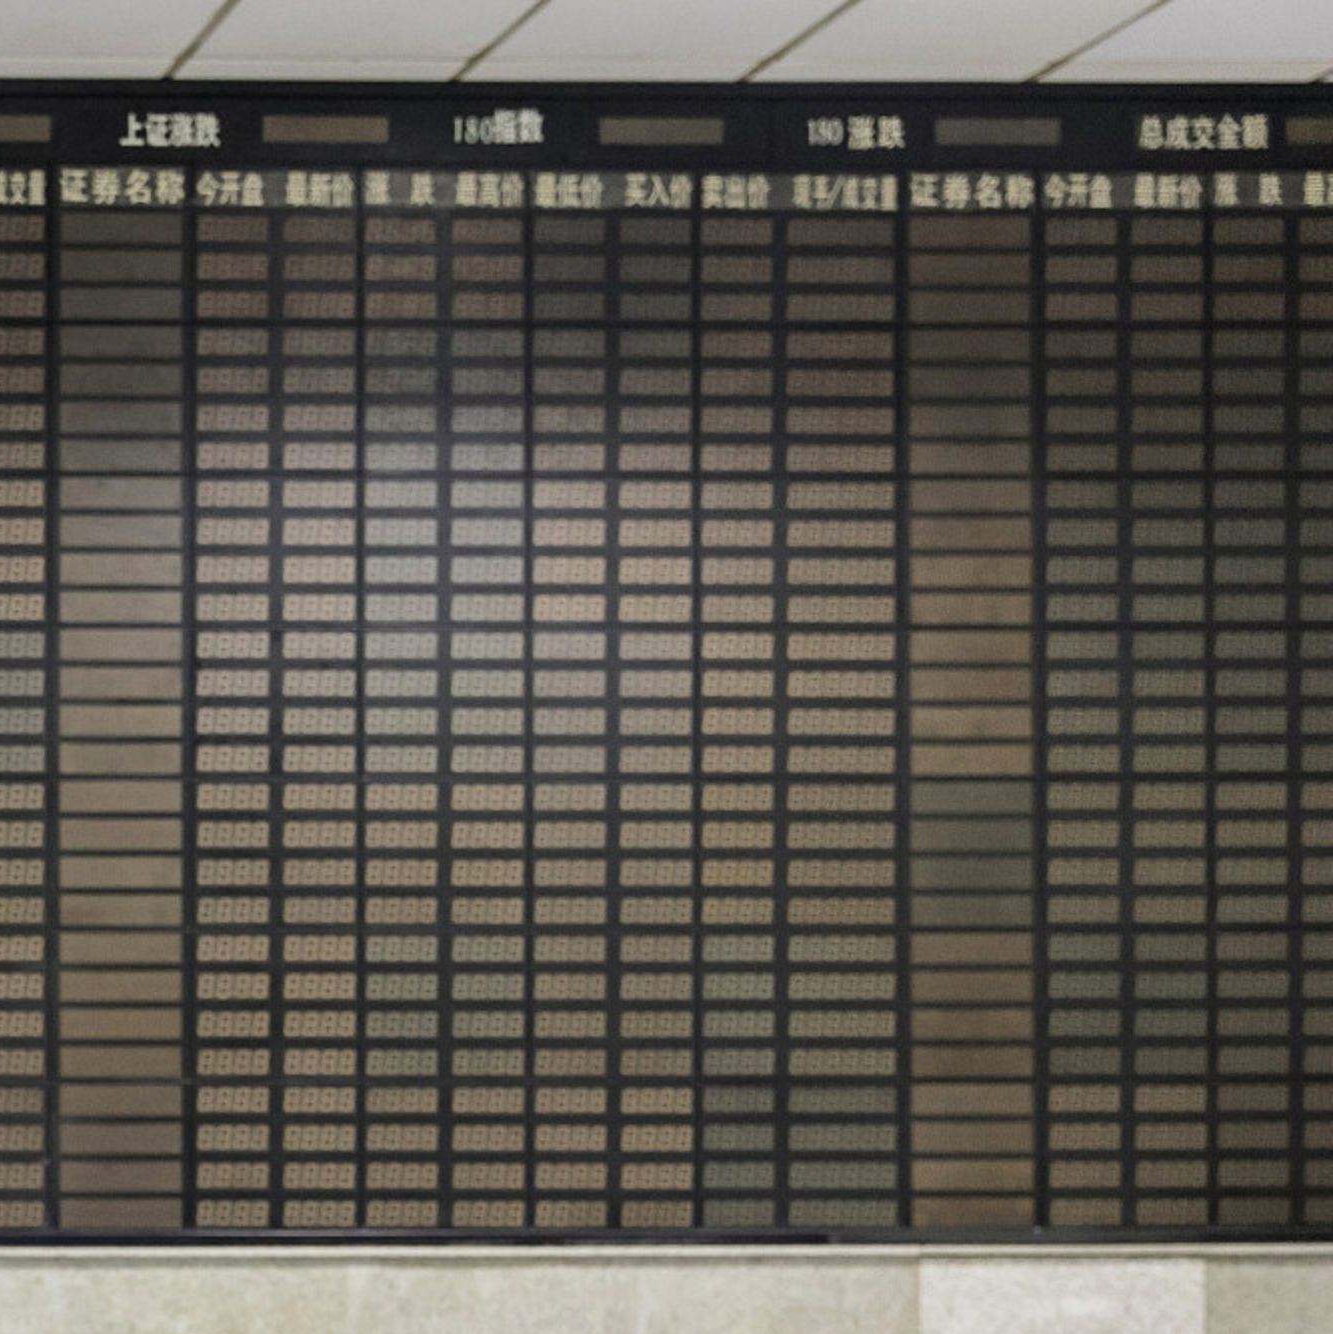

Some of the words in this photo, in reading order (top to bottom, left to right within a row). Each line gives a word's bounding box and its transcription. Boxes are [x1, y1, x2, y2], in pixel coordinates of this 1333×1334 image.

[120, 113, 220, 148] 上证涨跌
[1139, 114, 1269, 150] 总成交金额
[60, 168, 185, 205] 证券名称
[196, 171, 265, 207] 今开盘
[285, 171, 354, 208] 最新价
[454, 172, 524, 208] 最高价
[534, 172, 604, 209] 最低价
[625, 172, 692, 209] 买入价
[702, 174, 770, 209] 卖出价
[910, 174, 1034, 210] 证券名称
[1044, 173, 1112, 209] 今开盘
[1133, 174, 1202, 209] 最新价
